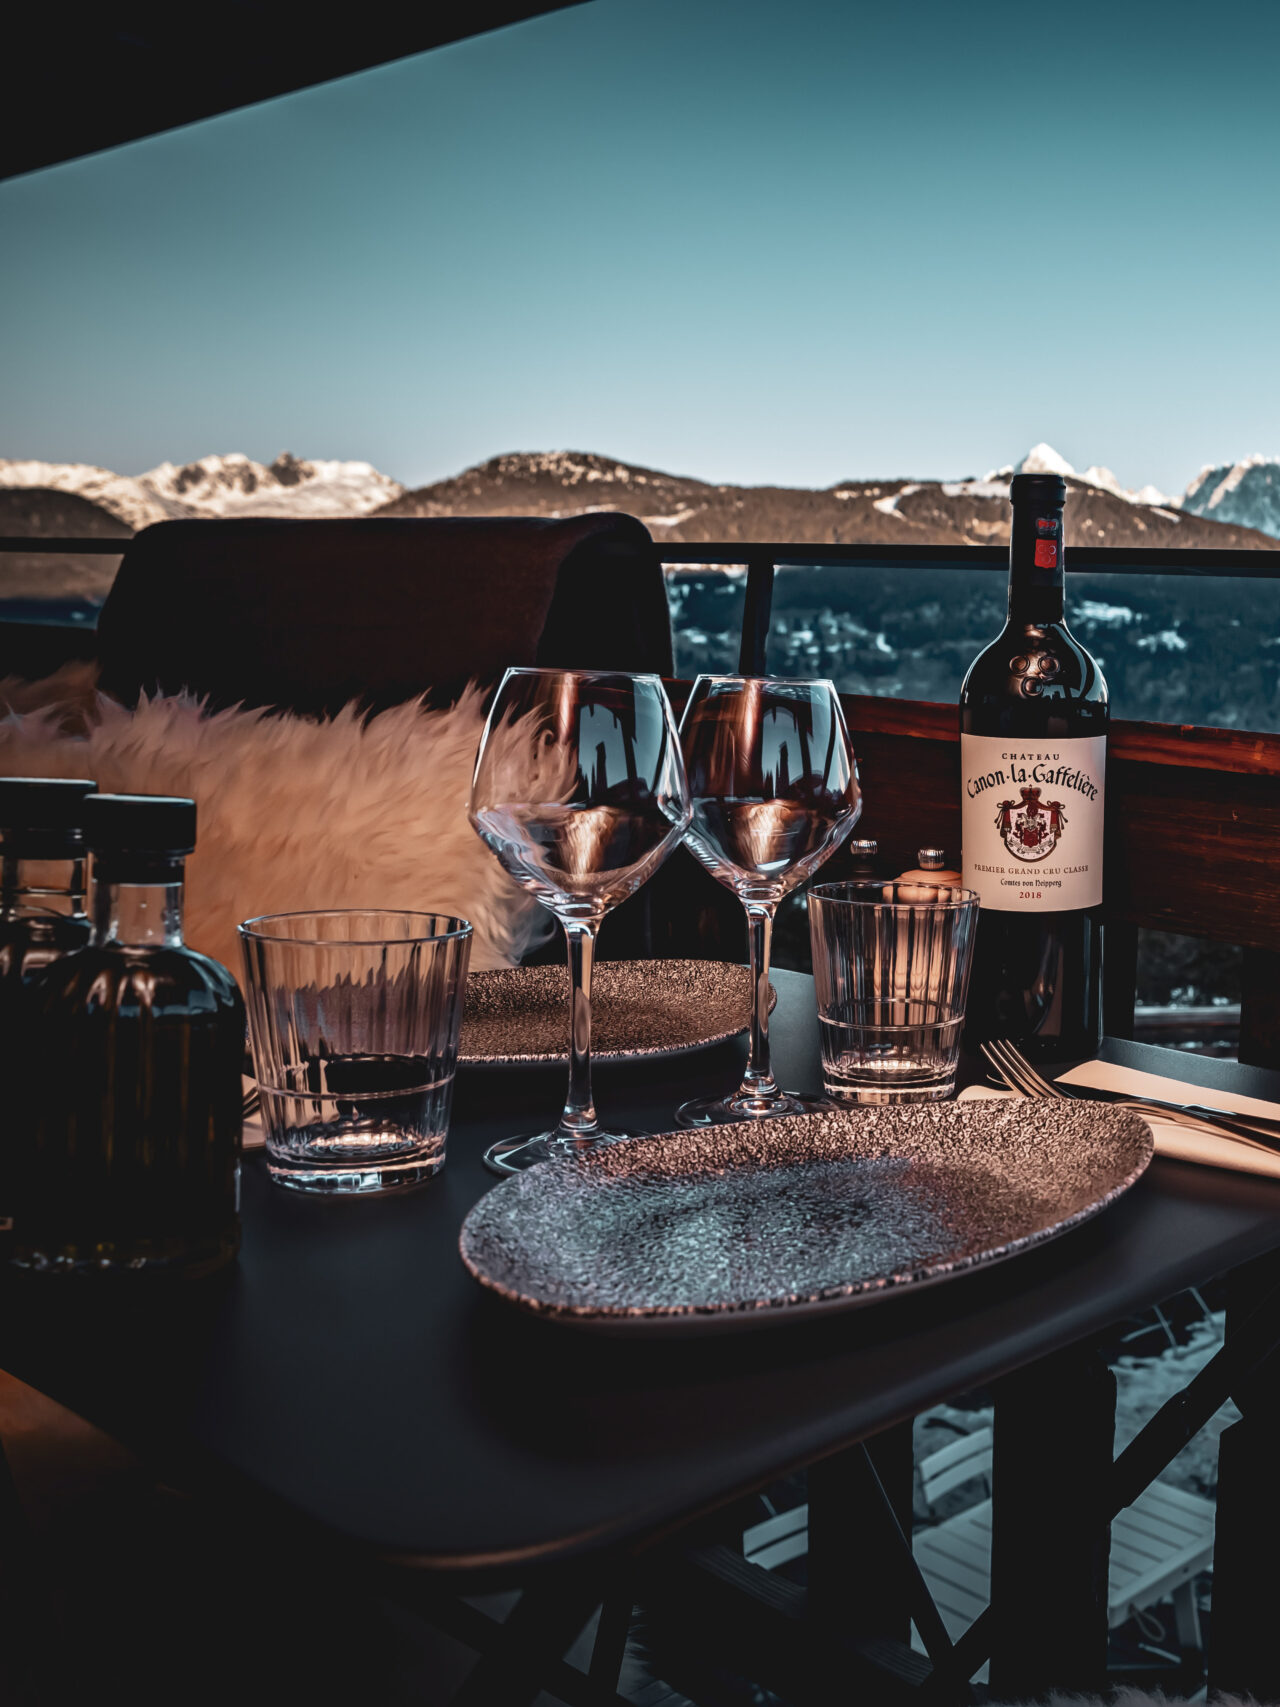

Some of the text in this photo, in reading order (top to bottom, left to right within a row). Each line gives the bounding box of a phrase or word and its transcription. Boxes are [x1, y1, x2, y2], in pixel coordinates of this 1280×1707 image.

[1001, 752, 1061, 761] CHATEAU
[974, 863, 1006, 874] PREMIER
[1008, 867, 1040, 875] GRAND
[1043, 867, 1061, 875] CRU
[1000, 878, 1021, 887] Comtes
[1019, 891, 1042, 899] 2018
